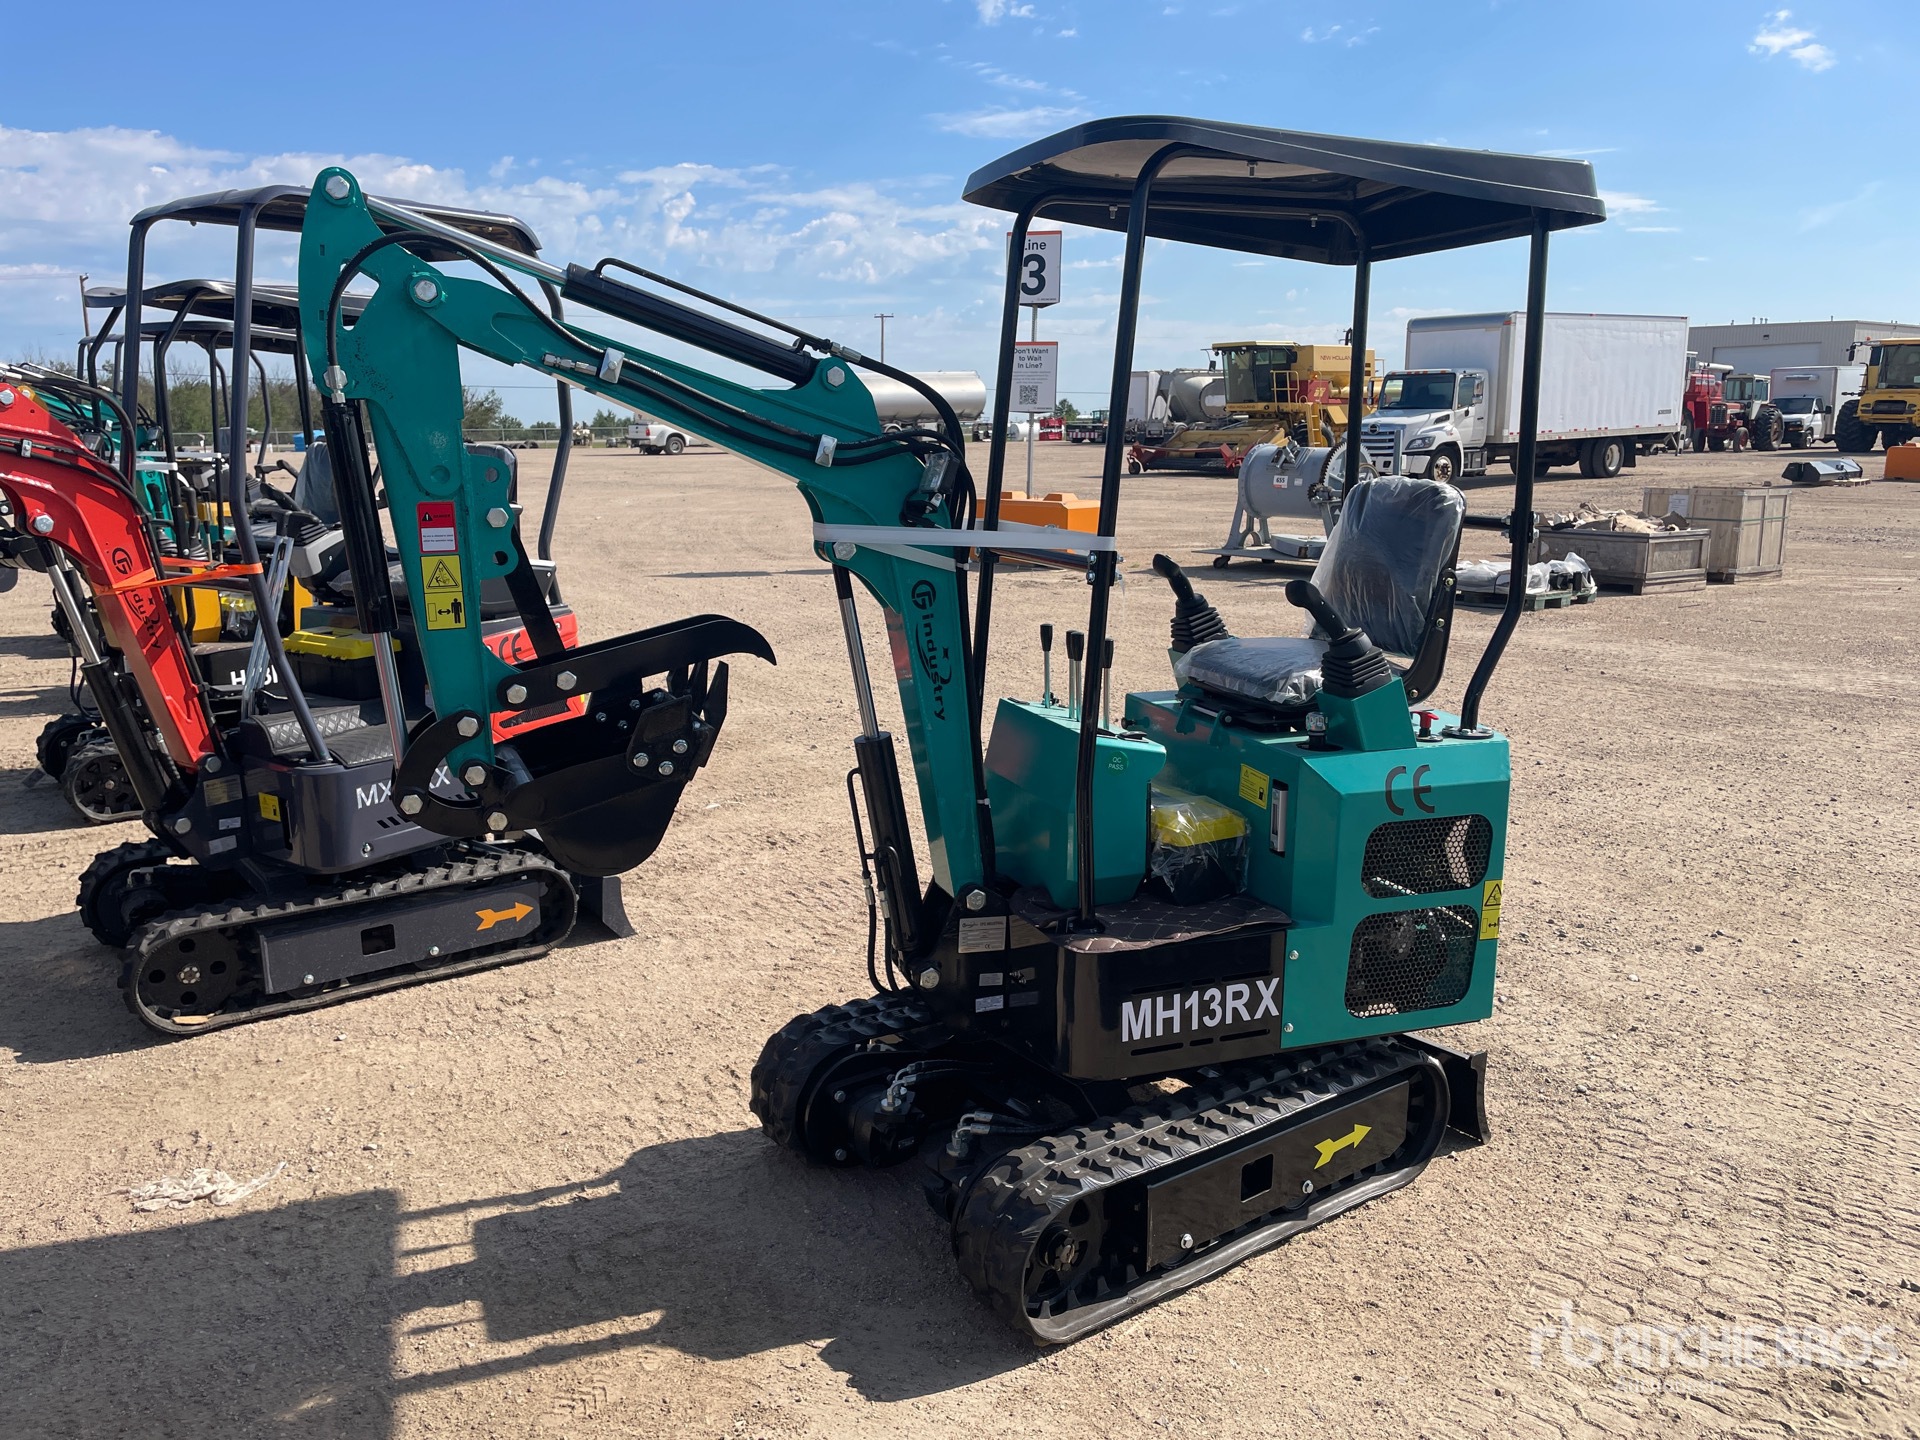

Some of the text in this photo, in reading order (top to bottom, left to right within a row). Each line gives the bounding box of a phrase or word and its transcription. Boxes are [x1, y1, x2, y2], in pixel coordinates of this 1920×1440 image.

[1024, 239, 1047, 251] ine
[1021, 253, 1047, 296] 3
[1032, 347, 1049, 355] Want
[1384, 763, 1435, 817] CE
[1120, 977, 1281, 1044] MH13RX
